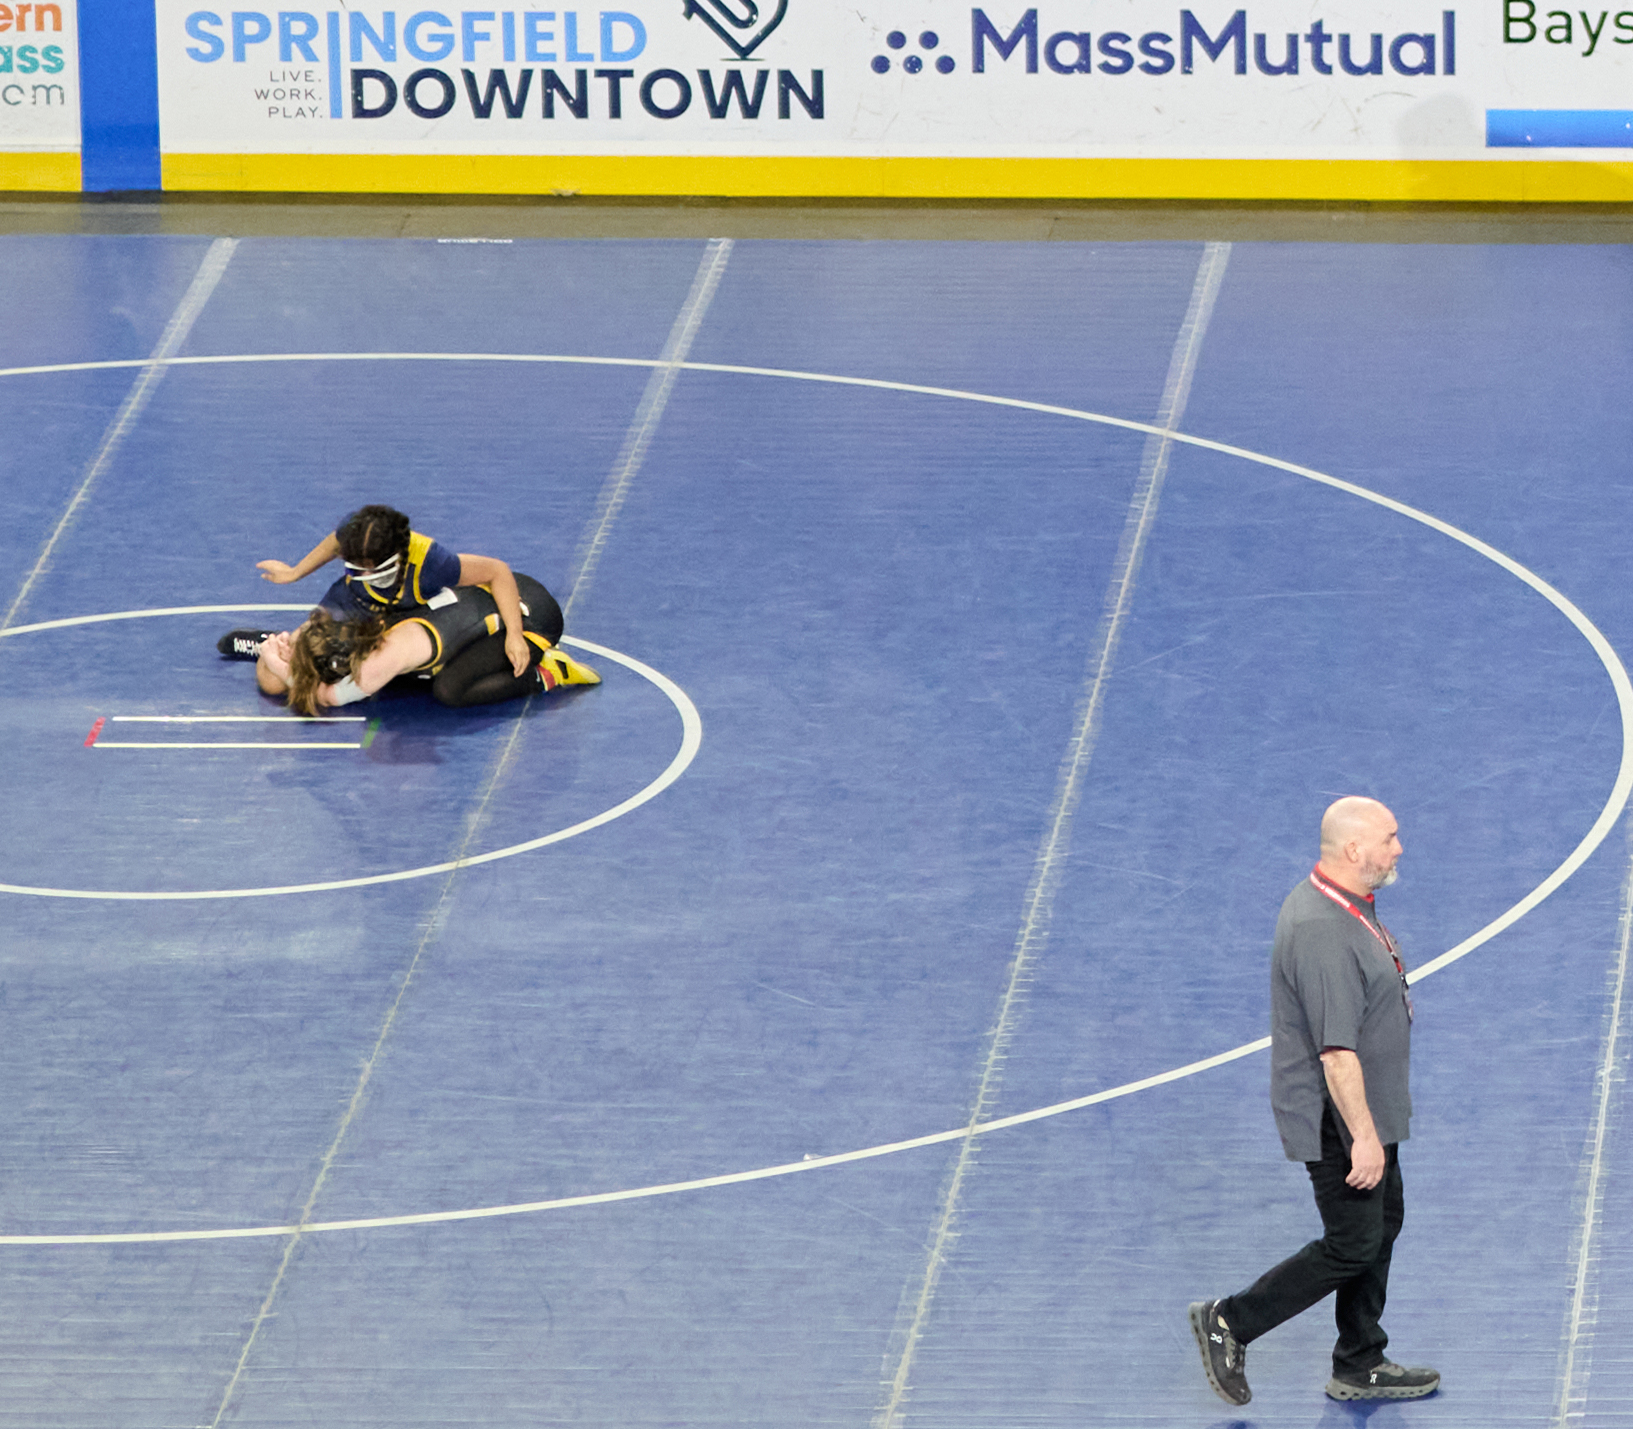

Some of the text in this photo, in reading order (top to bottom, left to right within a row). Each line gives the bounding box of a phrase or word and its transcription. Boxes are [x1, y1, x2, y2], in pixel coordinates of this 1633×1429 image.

[185, 11, 647, 80] SPRINGFIELD
[971, 8, 1456, 77] MassMutual
[269, 69, 322, 83] LIVE.
[254, 87, 323, 101] WORK.
[350, 68, 825, 120] DOWNTOWN
[268, 105, 323, 119] PLAY.
